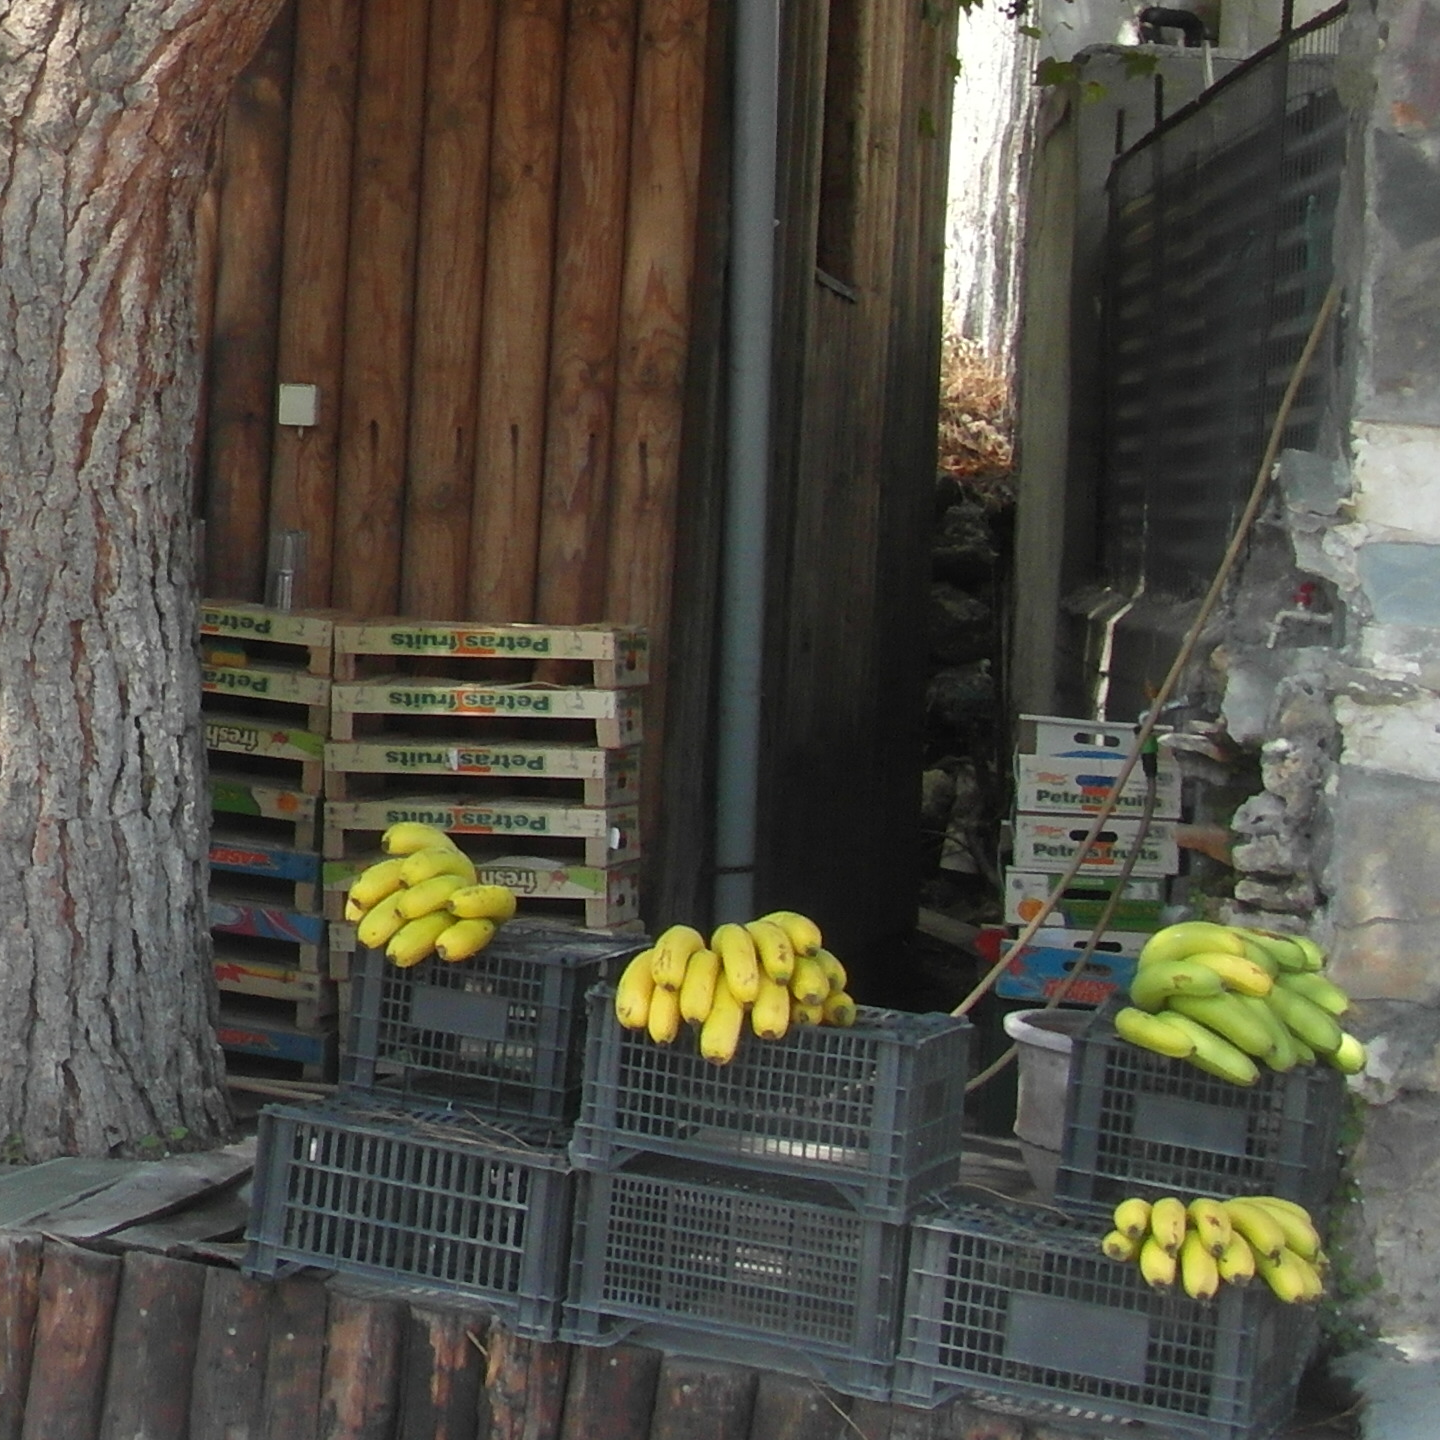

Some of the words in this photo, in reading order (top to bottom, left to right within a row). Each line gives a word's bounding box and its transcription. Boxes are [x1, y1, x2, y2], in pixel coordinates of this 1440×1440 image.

[205, 613, 271, 634] Petra
[390, 632, 457, 650] fruits
[465, 634, 549, 652] Petras
[202, 670, 268, 693] Petra
[389, 691, 457, 709] fruits
[464, 694, 549, 711] Petras
[206, 725, 259, 752] fresh
[385, 750, 454, 767] ruits
[460, 752, 544, 771] Petras
[1037, 789, 1103, 805] Petras
[462, 811, 546, 831] Petras
[1033, 843, 1100, 858] Petrs
